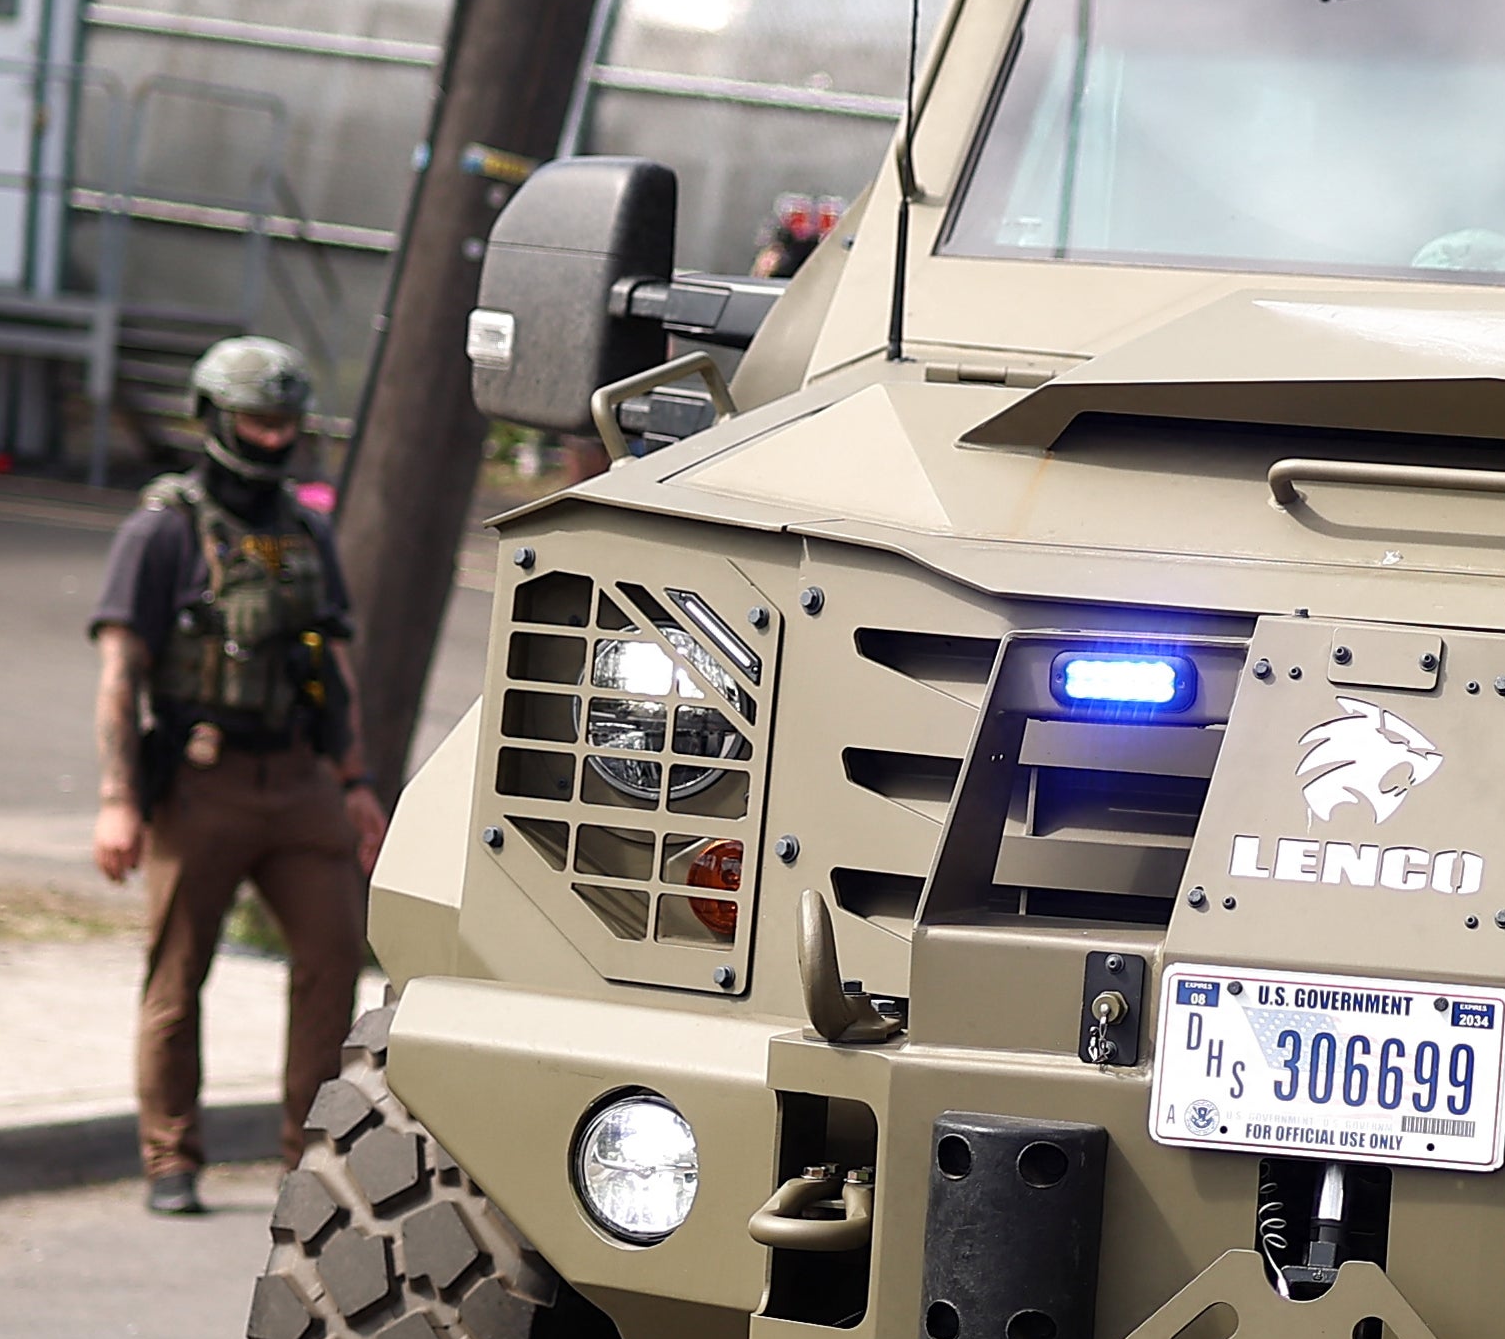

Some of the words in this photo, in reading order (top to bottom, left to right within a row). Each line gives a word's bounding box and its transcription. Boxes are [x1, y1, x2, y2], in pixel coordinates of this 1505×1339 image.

[1229, 834, 1483, 894] LENCO
[1190, 993, 1206, 1005] 08
[1258, 985, 1289, 1007] U.S.
[1295, 988, 1413, 1016] GOVERNMENT
[1458, 1013, 1489, 1028] 2034
[1274, 1029, 1475, 1116] 306699
[1166, 1104, 1175, 1124] A
[1245, 1123, 1271, 1140] FOR
[1275, 1125, 1335, 1146] OFFICIAL
[1339, 1130, 1365, 1147] USE
[1369, 1133, 1403, 1151] ONLY
